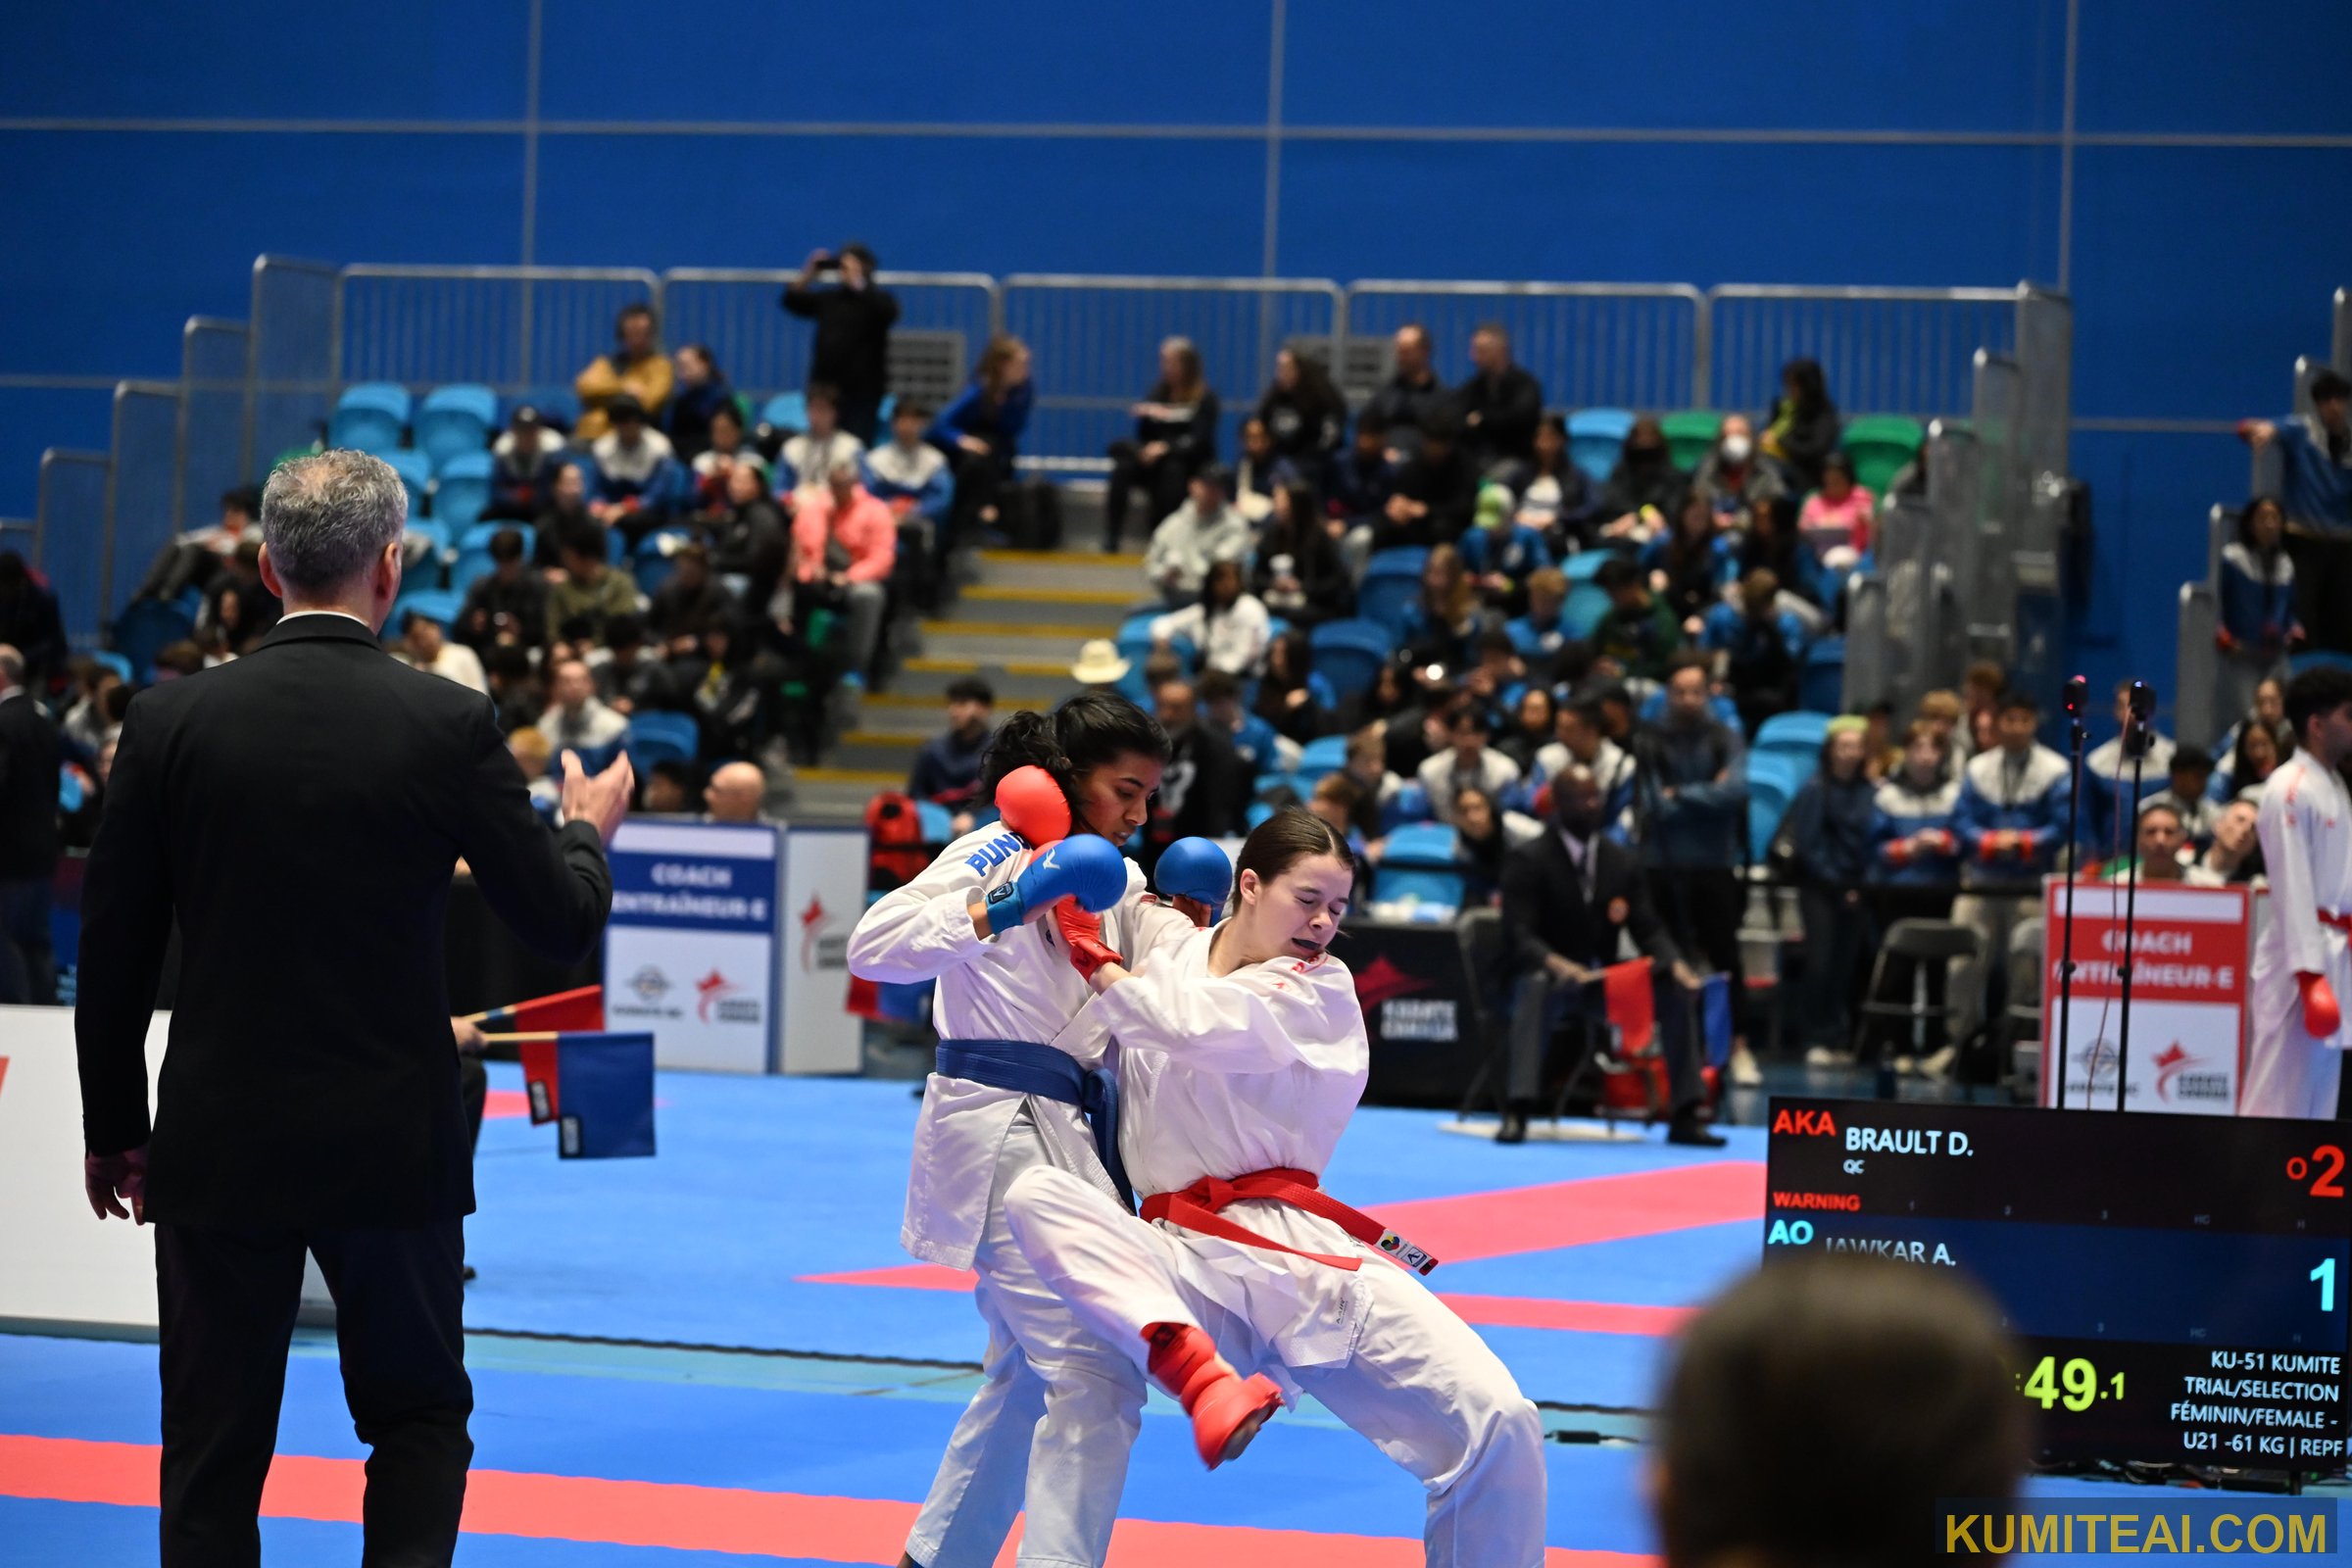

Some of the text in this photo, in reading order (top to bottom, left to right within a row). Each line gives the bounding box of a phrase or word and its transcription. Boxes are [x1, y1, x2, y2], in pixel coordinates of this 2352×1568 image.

[1773, 1109, 1837, 1137] AKA
[1845, 1127, 1974, 1157] BRAULT D.
[1842, 1158, 1865, 1175] QC
[2310, 1144, 2345, 1198] 2
[1773, 1192, 1861, 1211] WARNING
[1767, 1220, 1814, 1245] AO
[1932, 1243, 1957, 1266] A.
[2310, 1257, 2336, 1312] 1
[2211, 1350, 2341, 1375] KU-51 KUMITE
[2183, 1376, 2339, 1402] TRIAL/SELECTION
[2171, 1399, 2326, 1429] FÉMININ/FEMALE
[2183, 1431, 2218, 1450] U21
[2225, 1434, 2252, 1452] -61
[2259, 1436, 2284, 1454] KG
